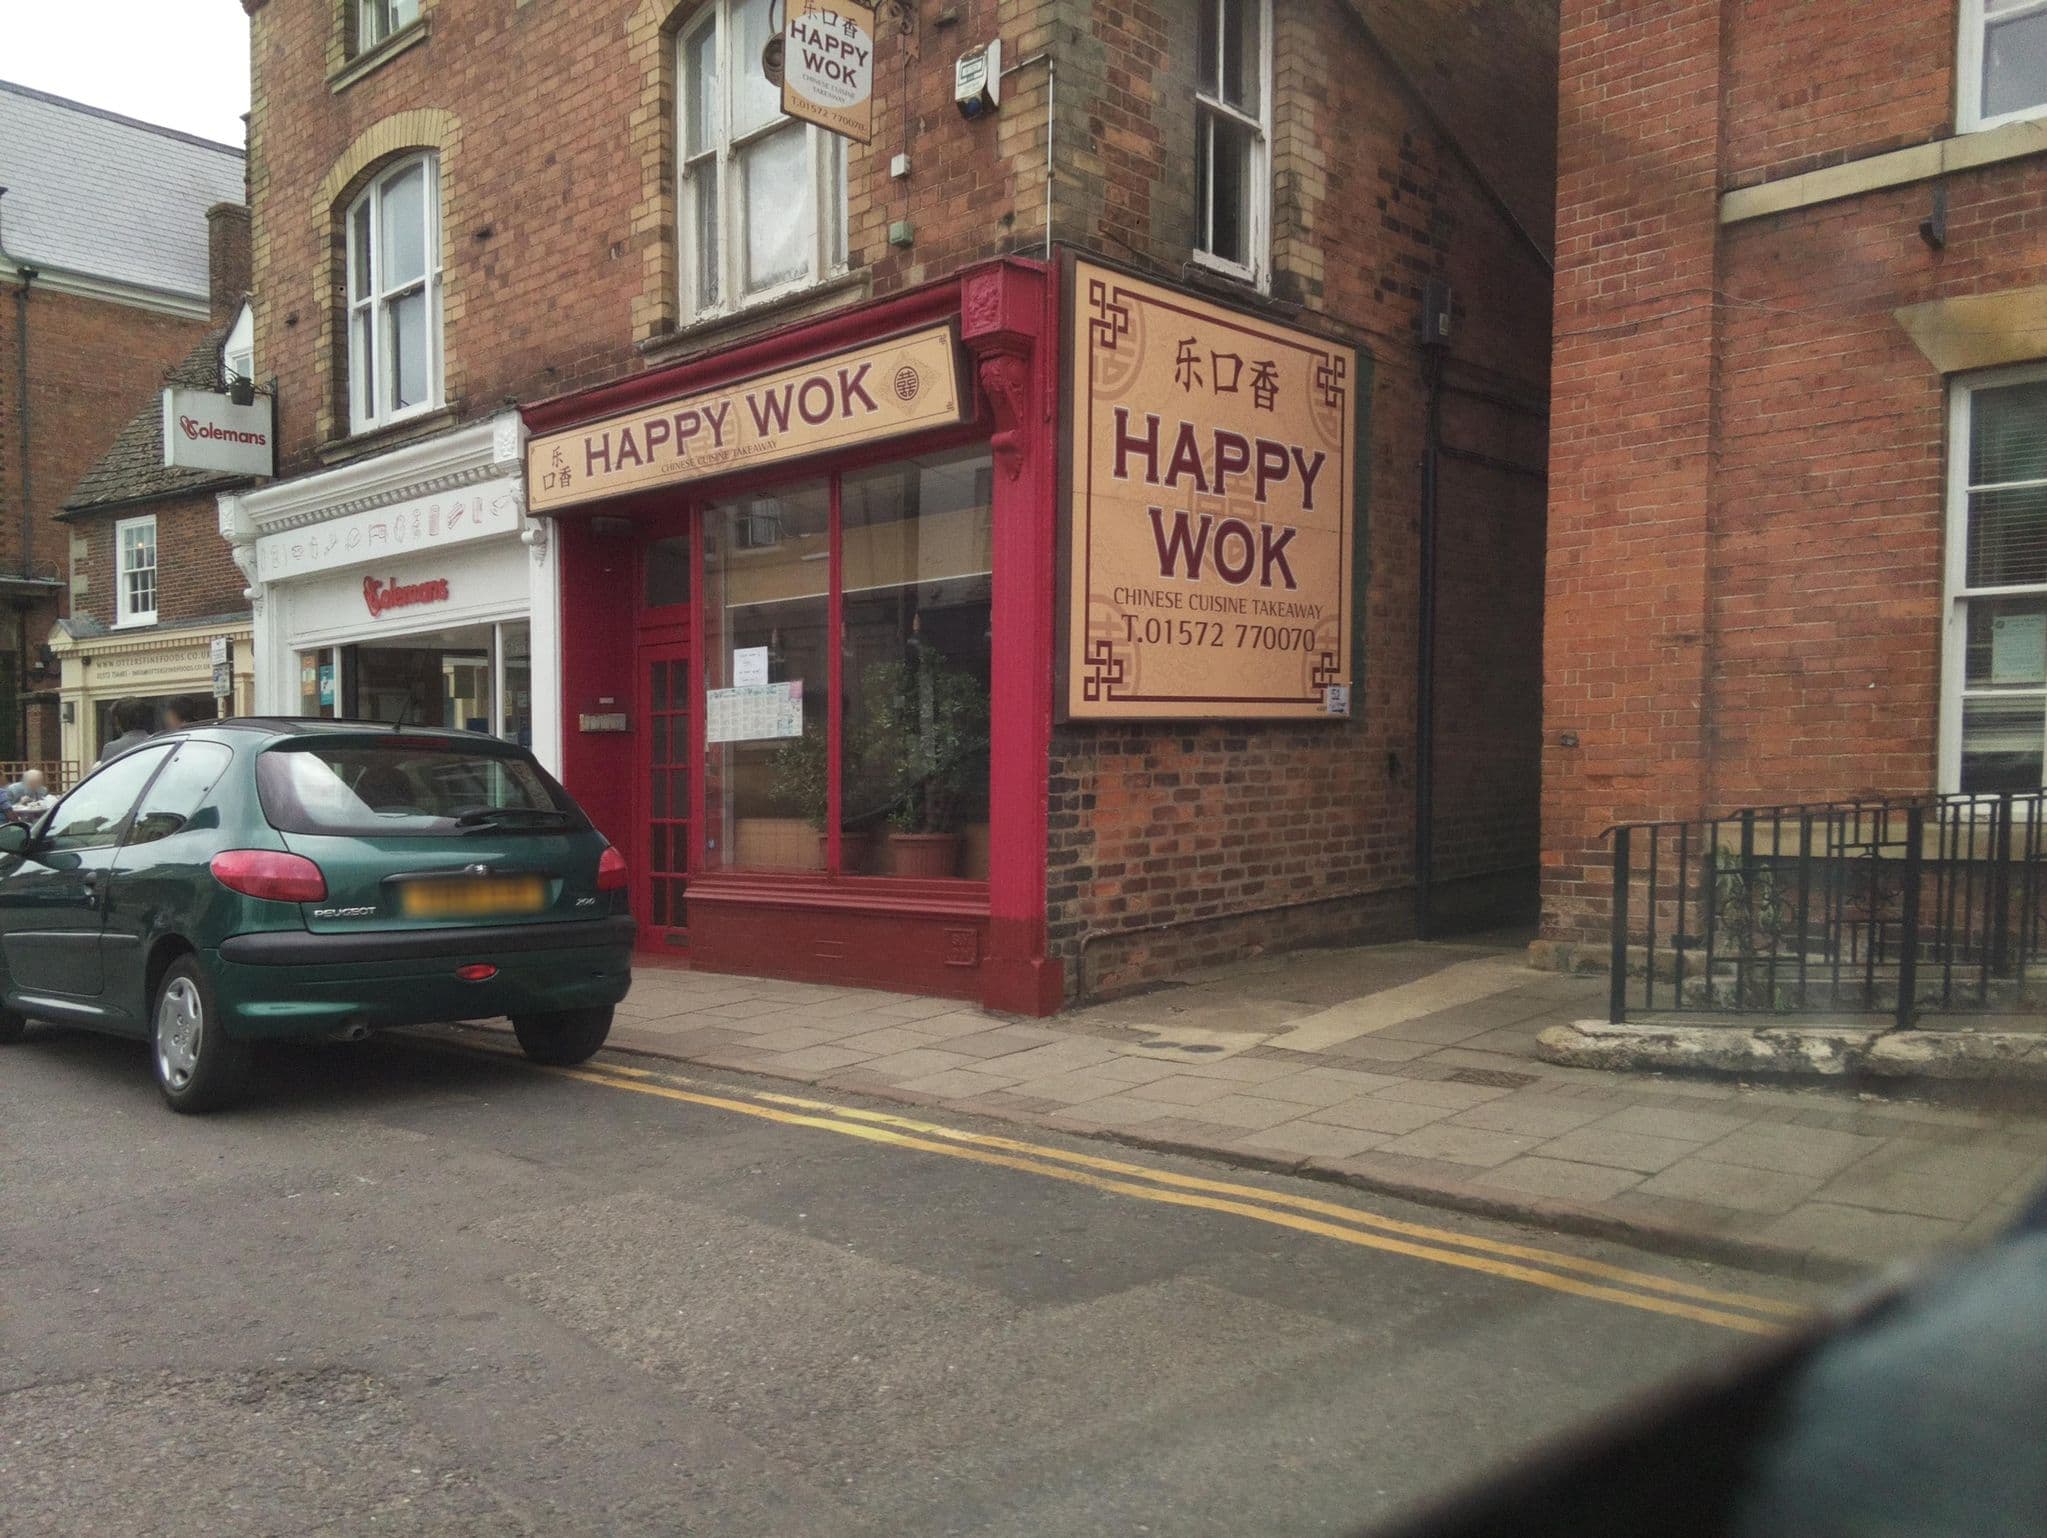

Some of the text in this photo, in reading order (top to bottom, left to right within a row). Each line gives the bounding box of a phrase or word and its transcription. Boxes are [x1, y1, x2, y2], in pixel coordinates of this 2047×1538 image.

[791, 19, 868, 67] HAPPY
[802, 48, 857, 88] WOK
[802, 73, 855, 98] CHINESE CUISINE
[813, 86, 846, 103] TAKEAWAY
[1174, 336, 1279, 412] 乐口香
[180, 415, 266, 446] Colemans
[585, 362, 878, 477] HAPPY WOK
[661, 440, 777, 473] CHINESE CUISINE TAKEAWAY
[1113, 406, 1326, 511] HAPPY
[1149, 507, 1297, 590] WOK
[363, 576, 449, 617] Colemans
[1113, 587, 1324, 620] CHINESE CUISINE TAKEAWAY
[1121, 614, 1316, 652] T.01572 770070
[314, 906, 377, 918] PEUGEOT
